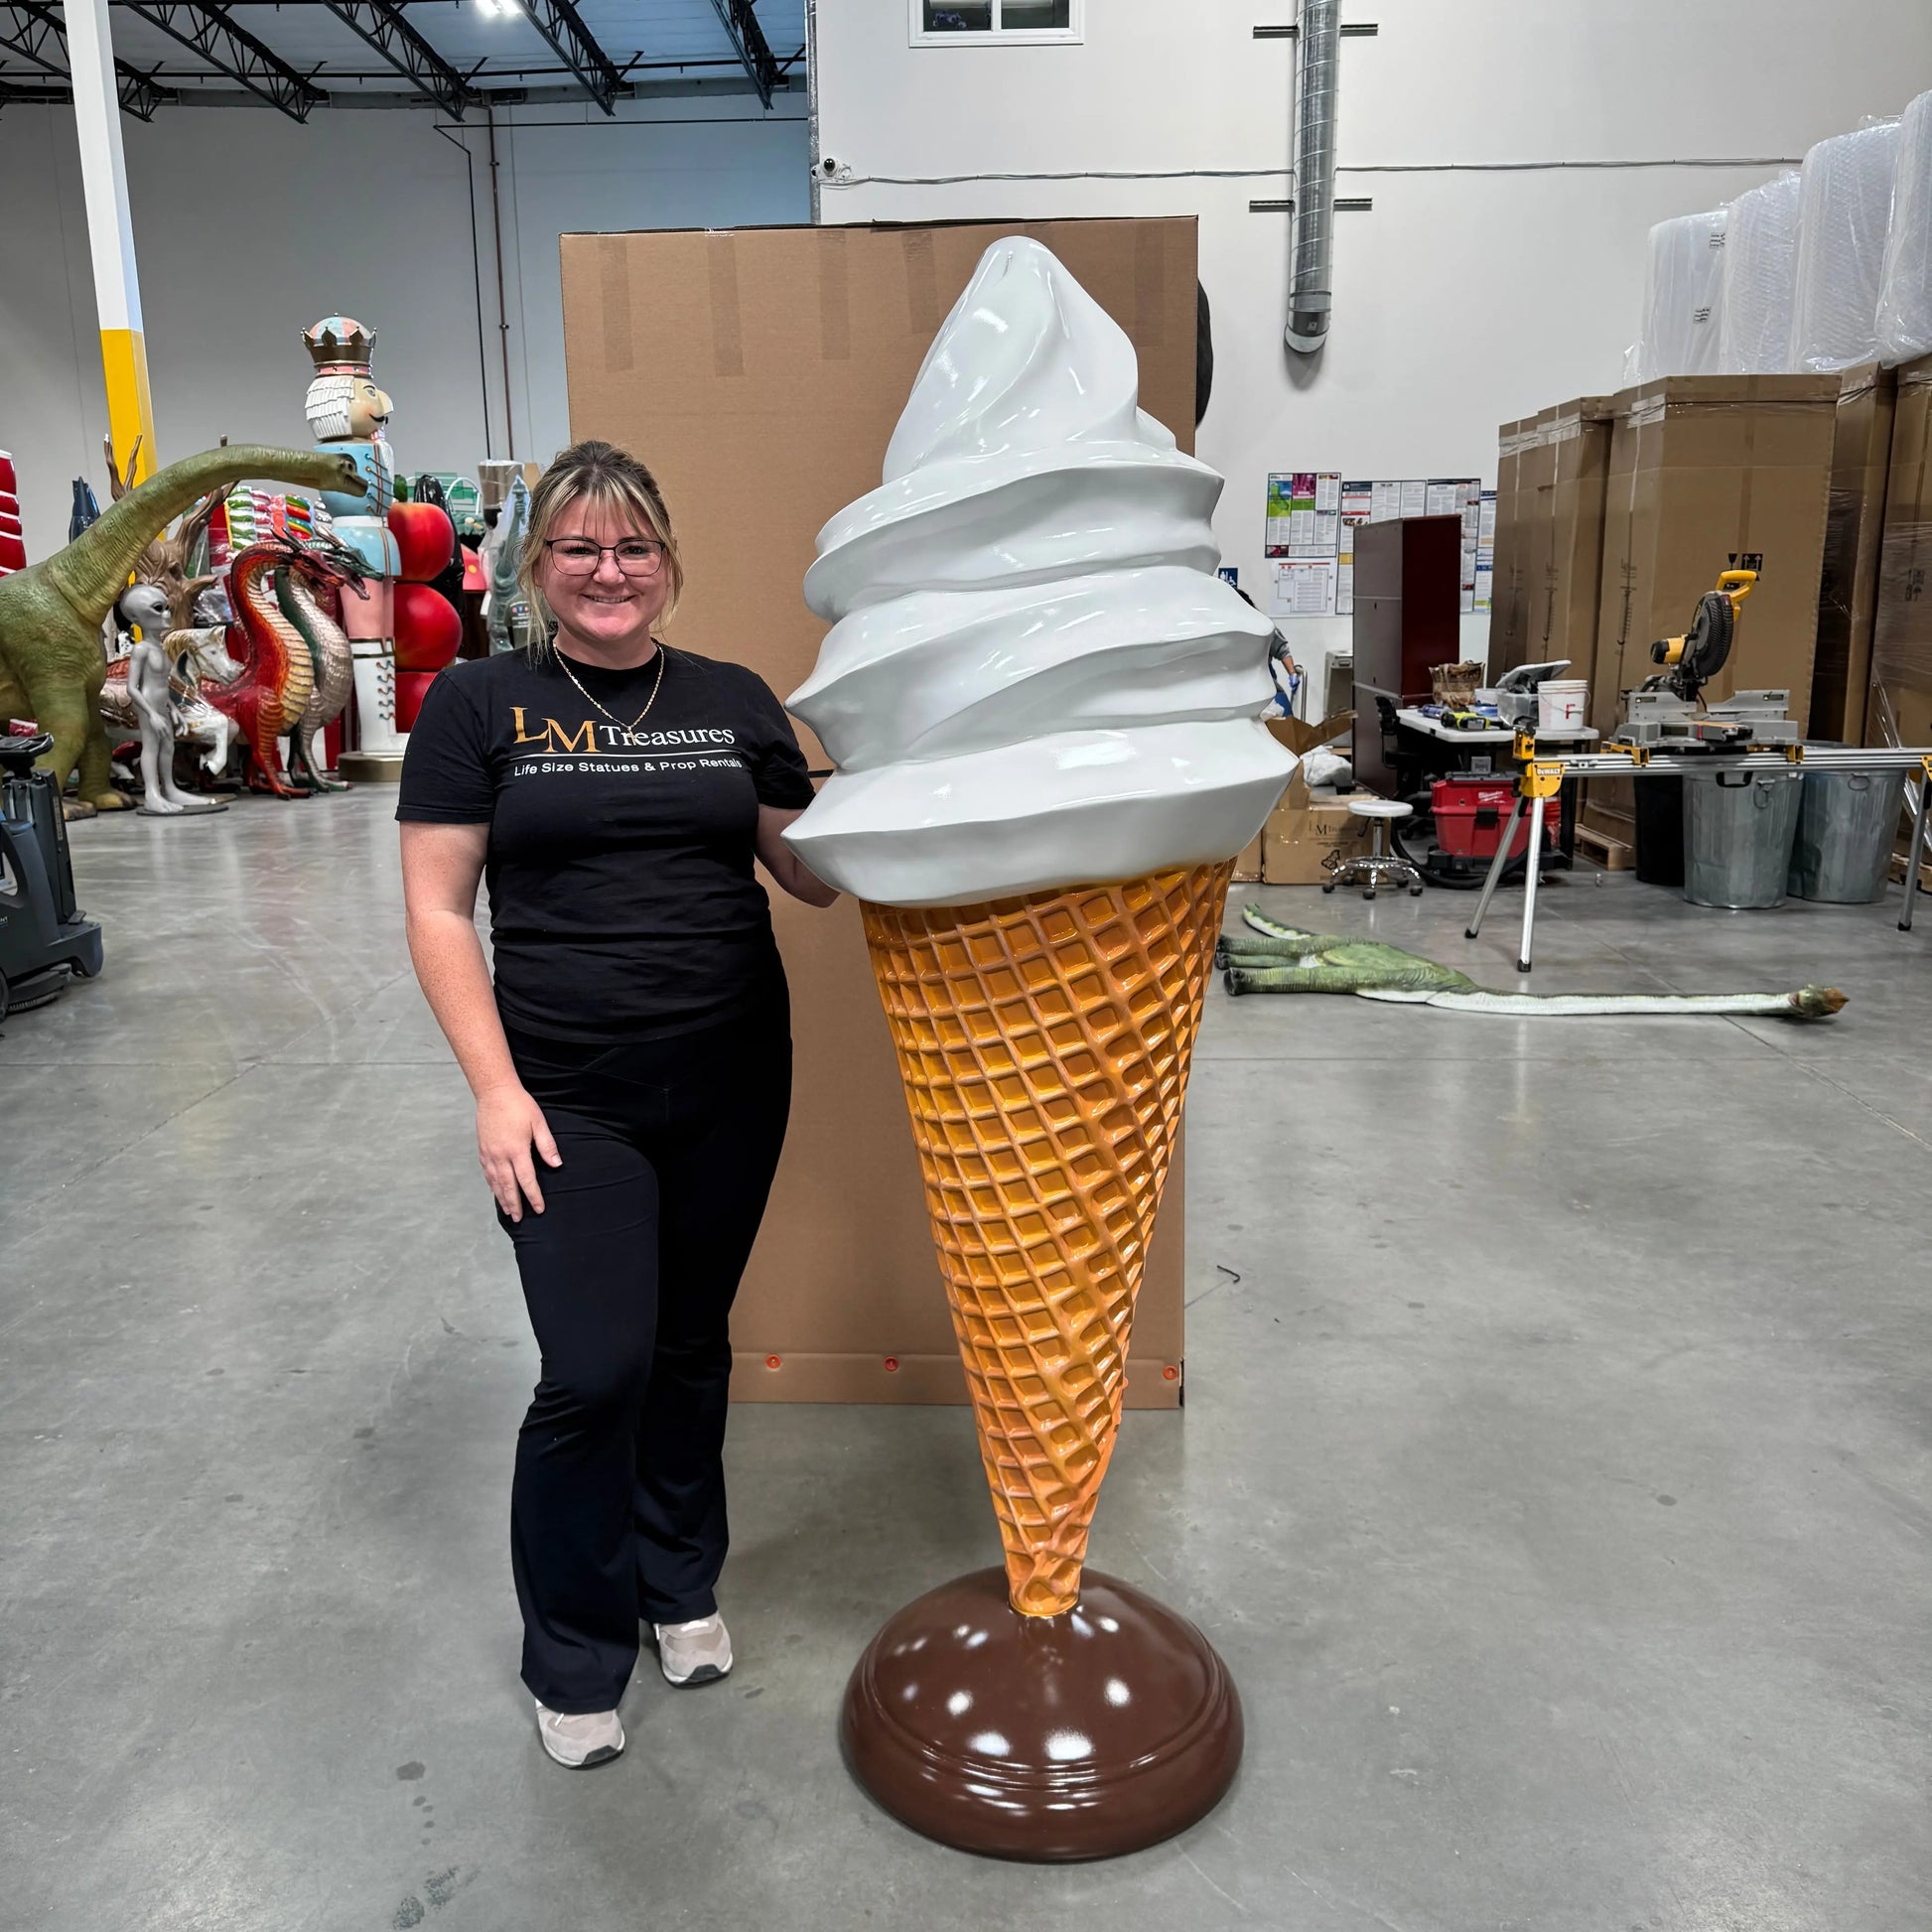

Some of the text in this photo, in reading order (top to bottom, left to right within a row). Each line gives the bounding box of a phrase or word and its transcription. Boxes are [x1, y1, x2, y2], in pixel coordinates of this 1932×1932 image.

[509, 706, 735, 753] LM Treasures
[514, 758, 743, 776] Life Size Statues & Prop Rentals
